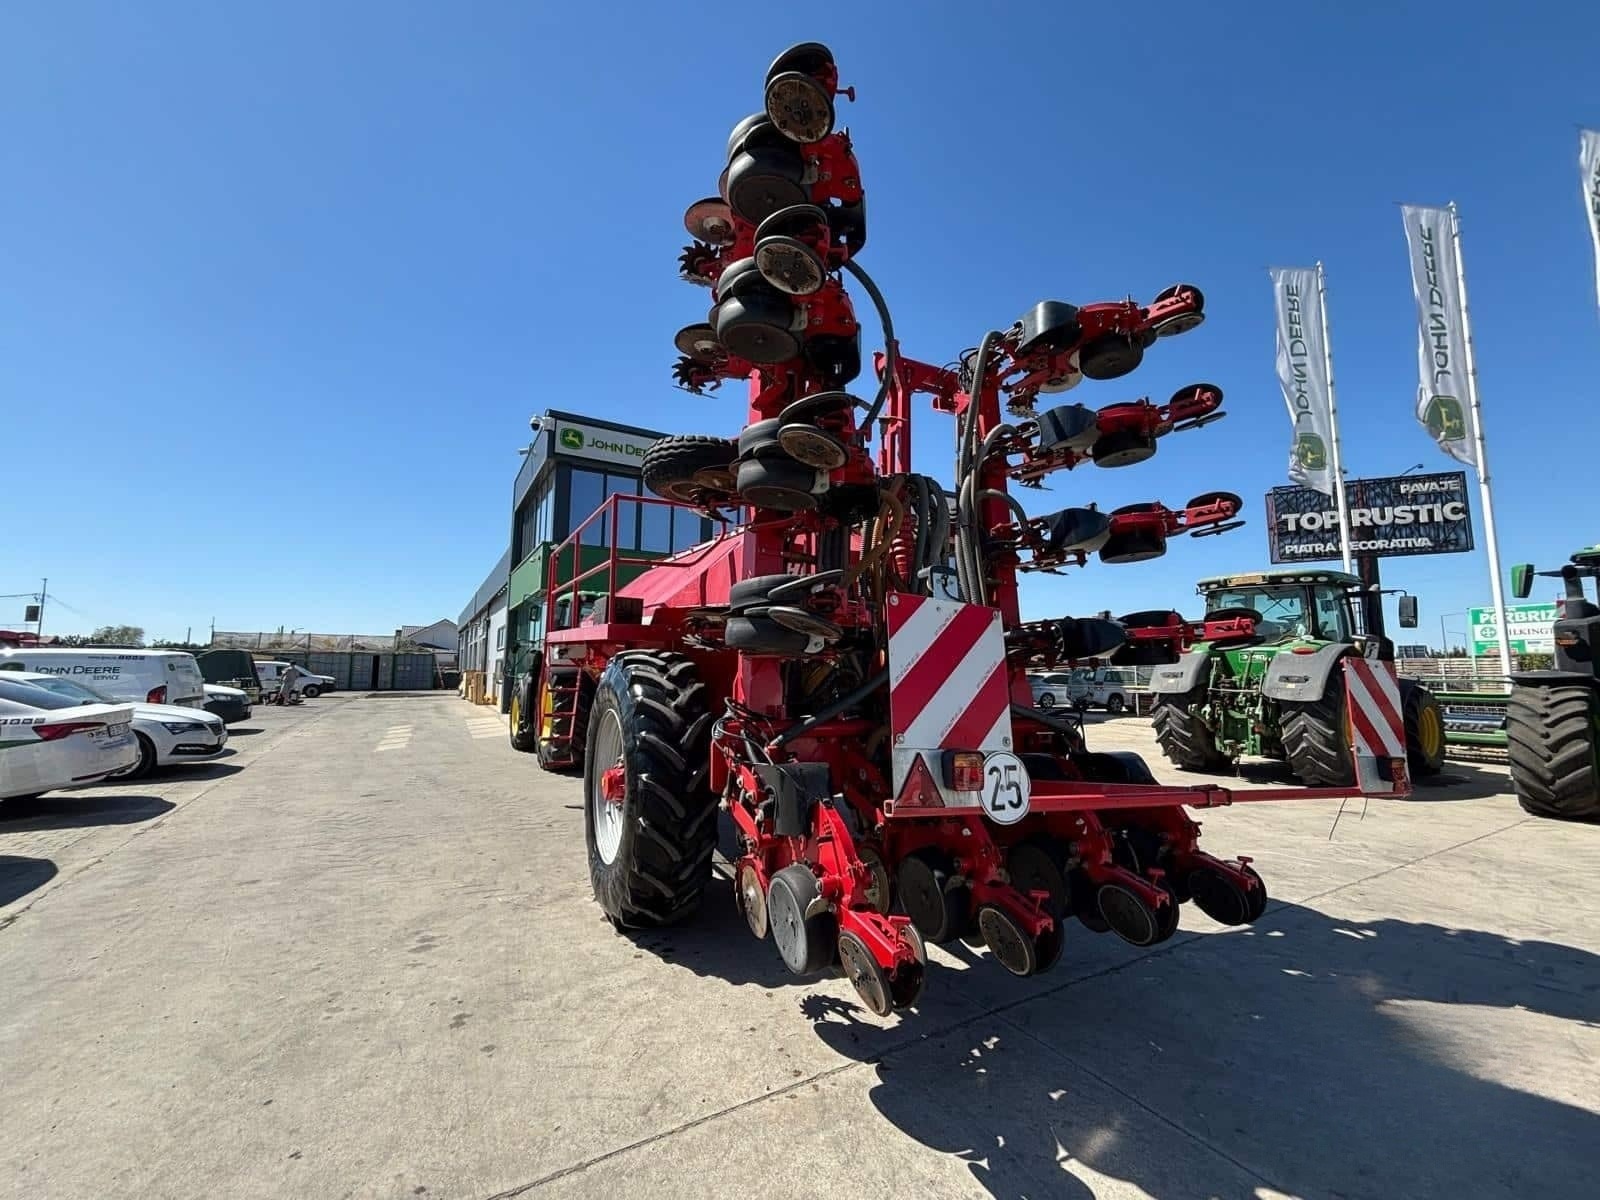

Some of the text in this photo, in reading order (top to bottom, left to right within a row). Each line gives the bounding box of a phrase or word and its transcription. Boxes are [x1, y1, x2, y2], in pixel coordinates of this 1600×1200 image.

[587, 437, 624, 453] JOHN
[1400, 480, 1460, 494] PAVAJE
[1281, 502, 1466, 531] TOP RUSTIC
[1285, 542, 1337, 554] PIATRA
[35, 665, 121, 675] JOHN DEERE
[988, 765, 1023, 811] 25
